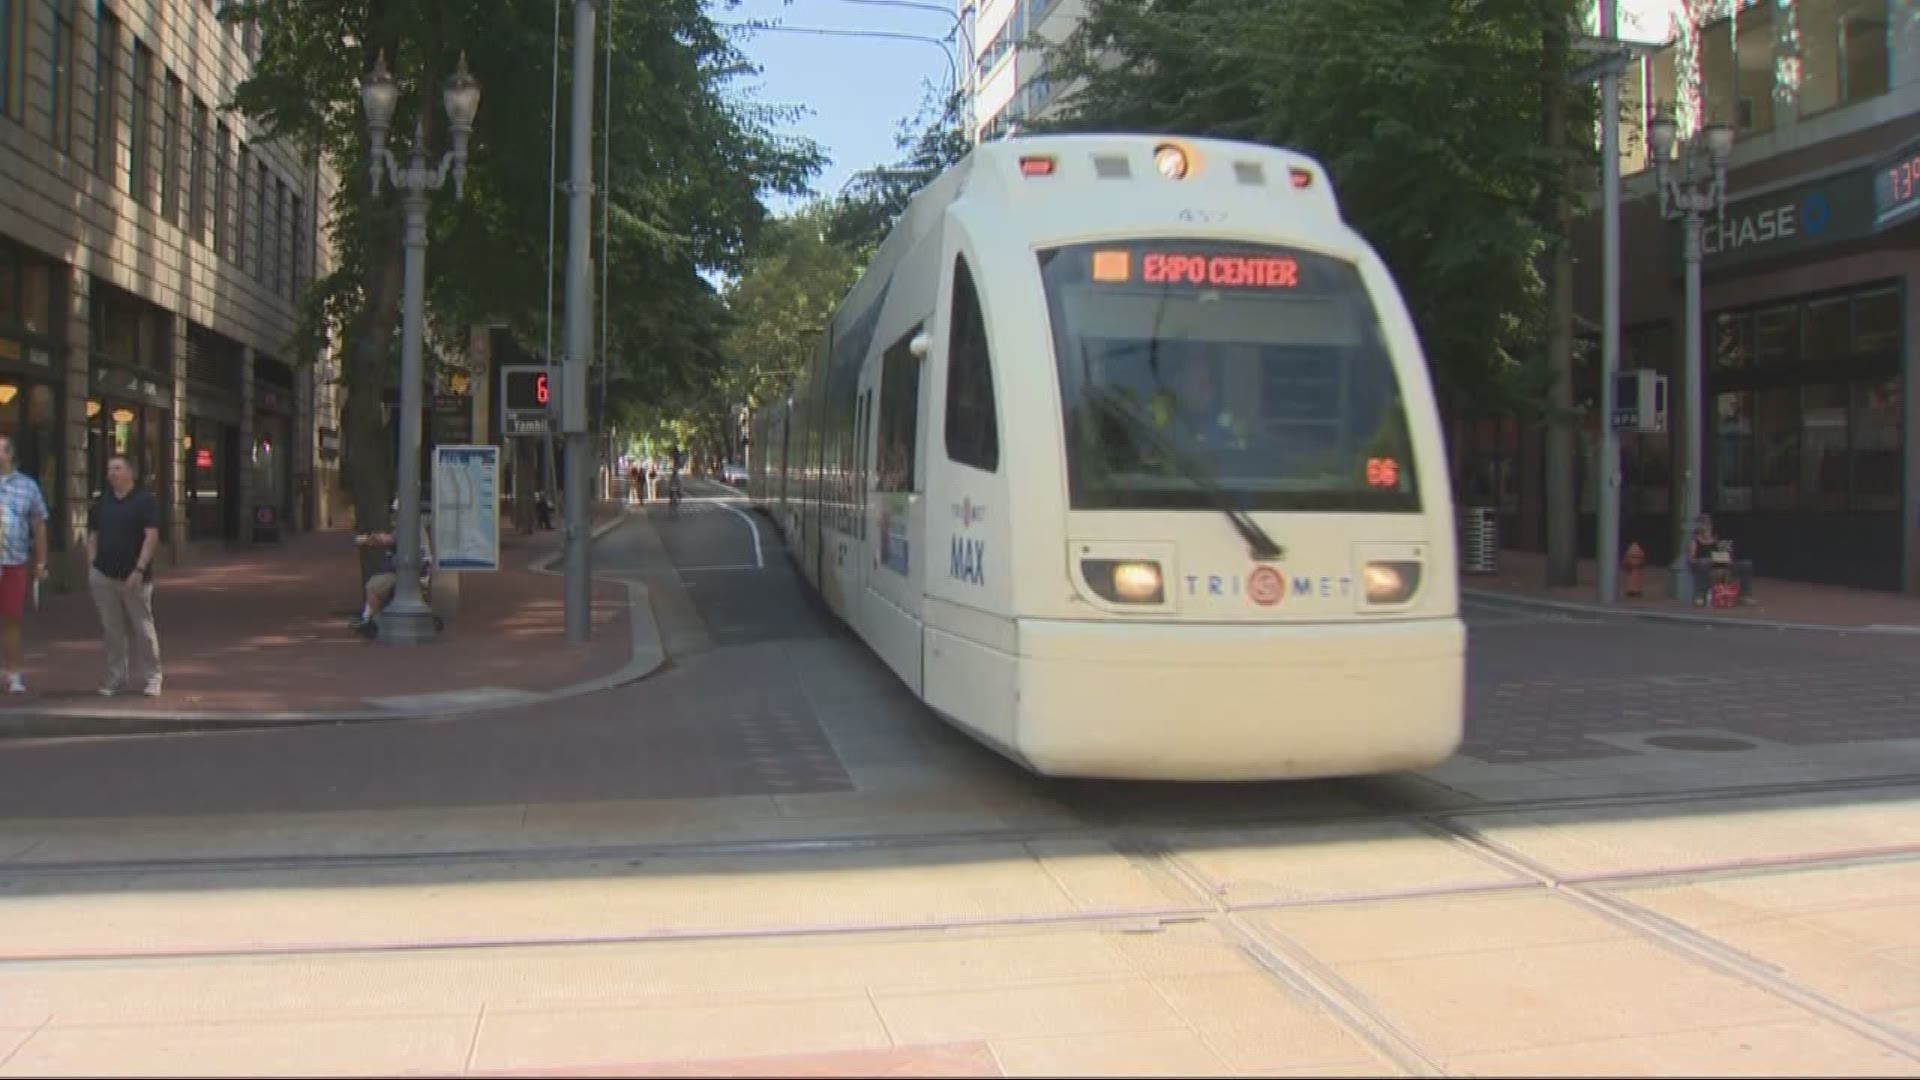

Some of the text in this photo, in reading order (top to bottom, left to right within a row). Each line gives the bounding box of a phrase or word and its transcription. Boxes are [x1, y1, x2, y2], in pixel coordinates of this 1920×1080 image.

[1701, 205, 1797, 254] CHASE
[1143, 253, 1298, 287] EXPO CENTER
[951, 532, 985, 587] MAX
[1185, 575, 1353, 598] TRI MET
